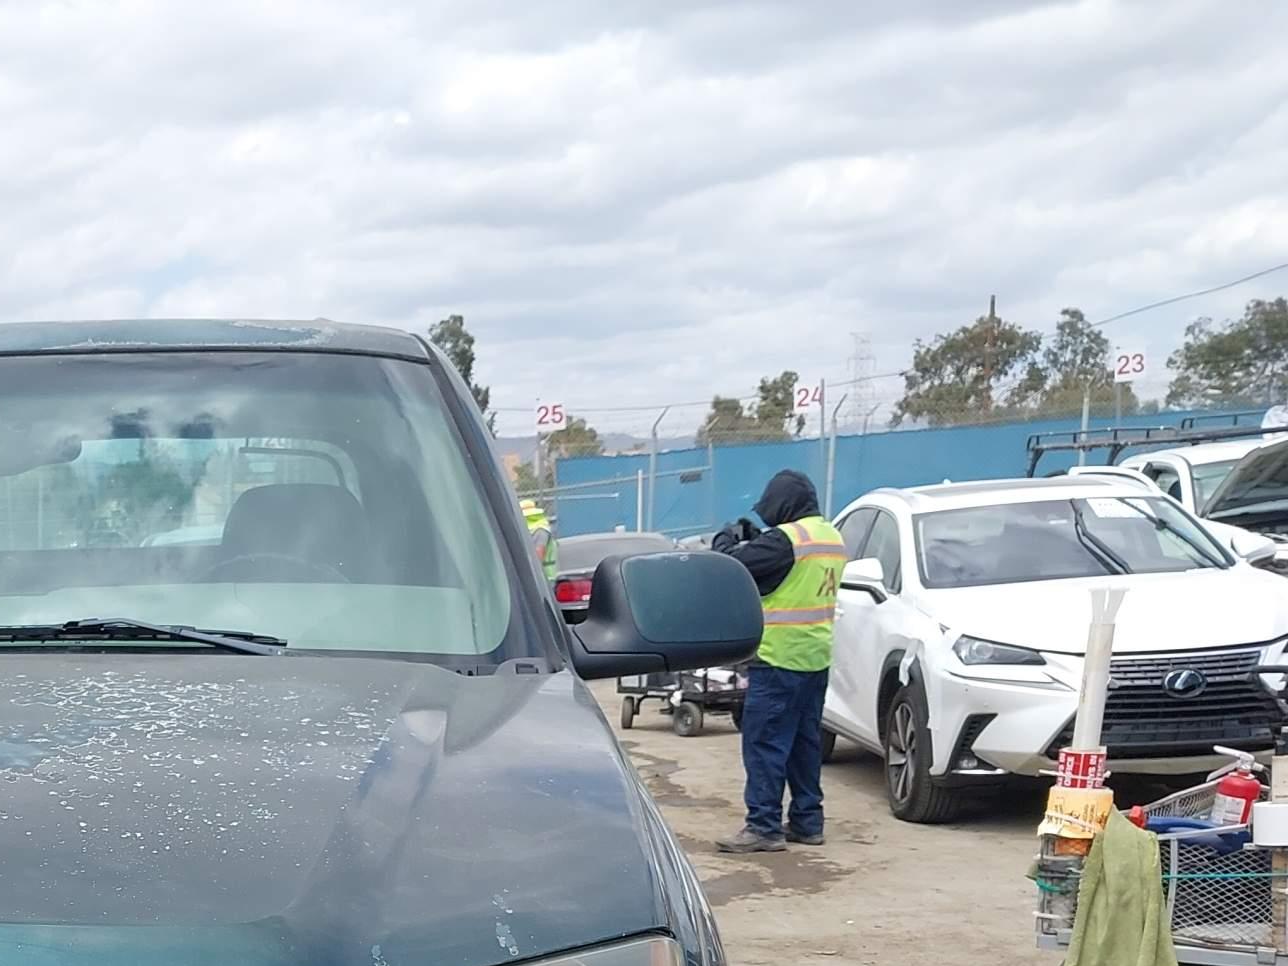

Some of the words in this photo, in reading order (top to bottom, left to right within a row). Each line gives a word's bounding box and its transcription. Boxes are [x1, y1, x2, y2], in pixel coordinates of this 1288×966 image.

[1116, 353, 1145, 375] 23
[797, 386, 823, 407] 24
[536, 404, 564, 425] 25
